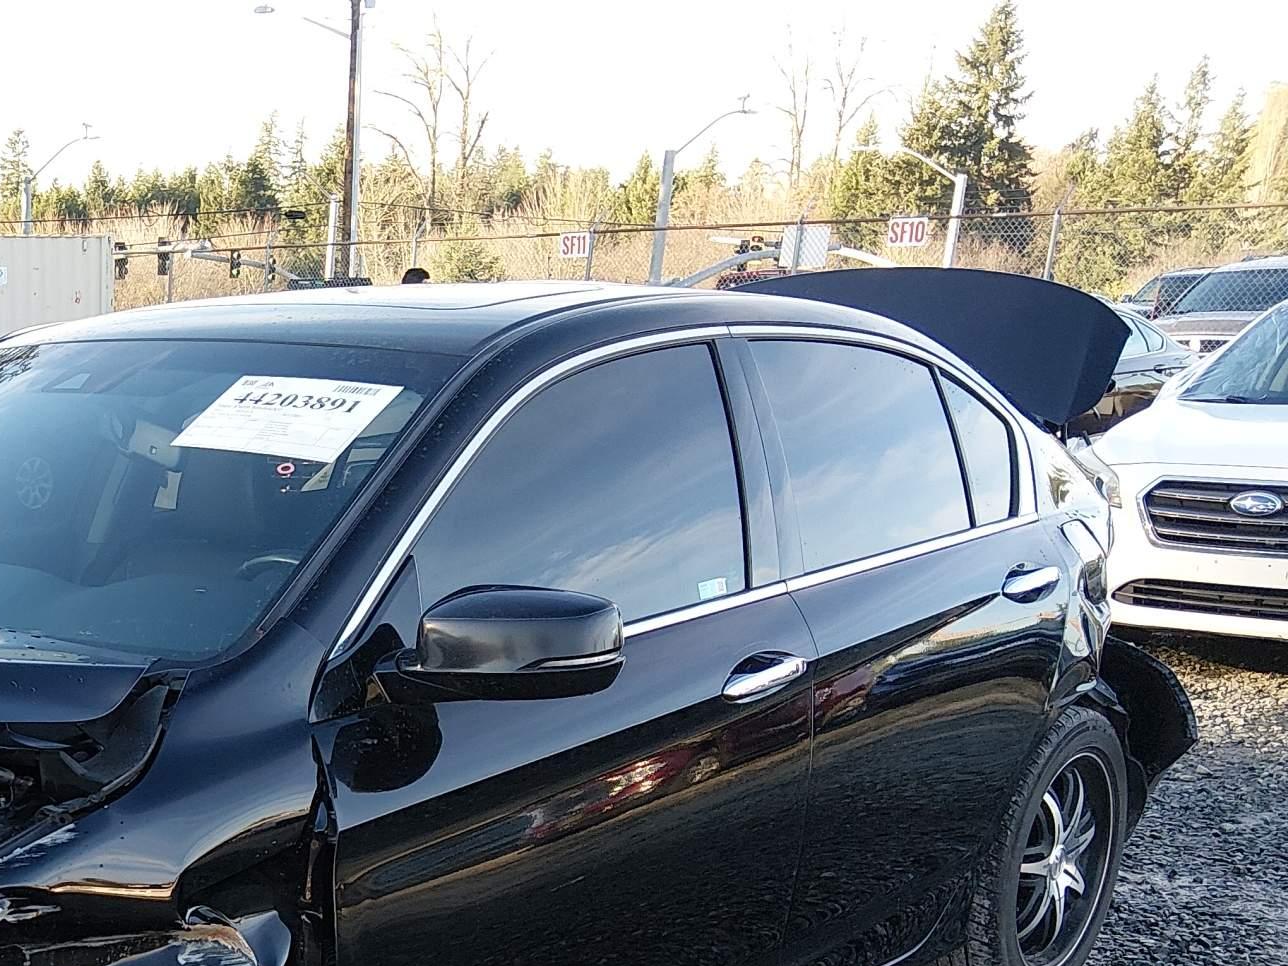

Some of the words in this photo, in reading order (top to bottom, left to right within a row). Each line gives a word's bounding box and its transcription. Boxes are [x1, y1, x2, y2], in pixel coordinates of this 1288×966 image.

[889, 220, 925, 244] SF10
[562, 235, 586, 255] SF11
[234, 391, 361, 413] 44203891
